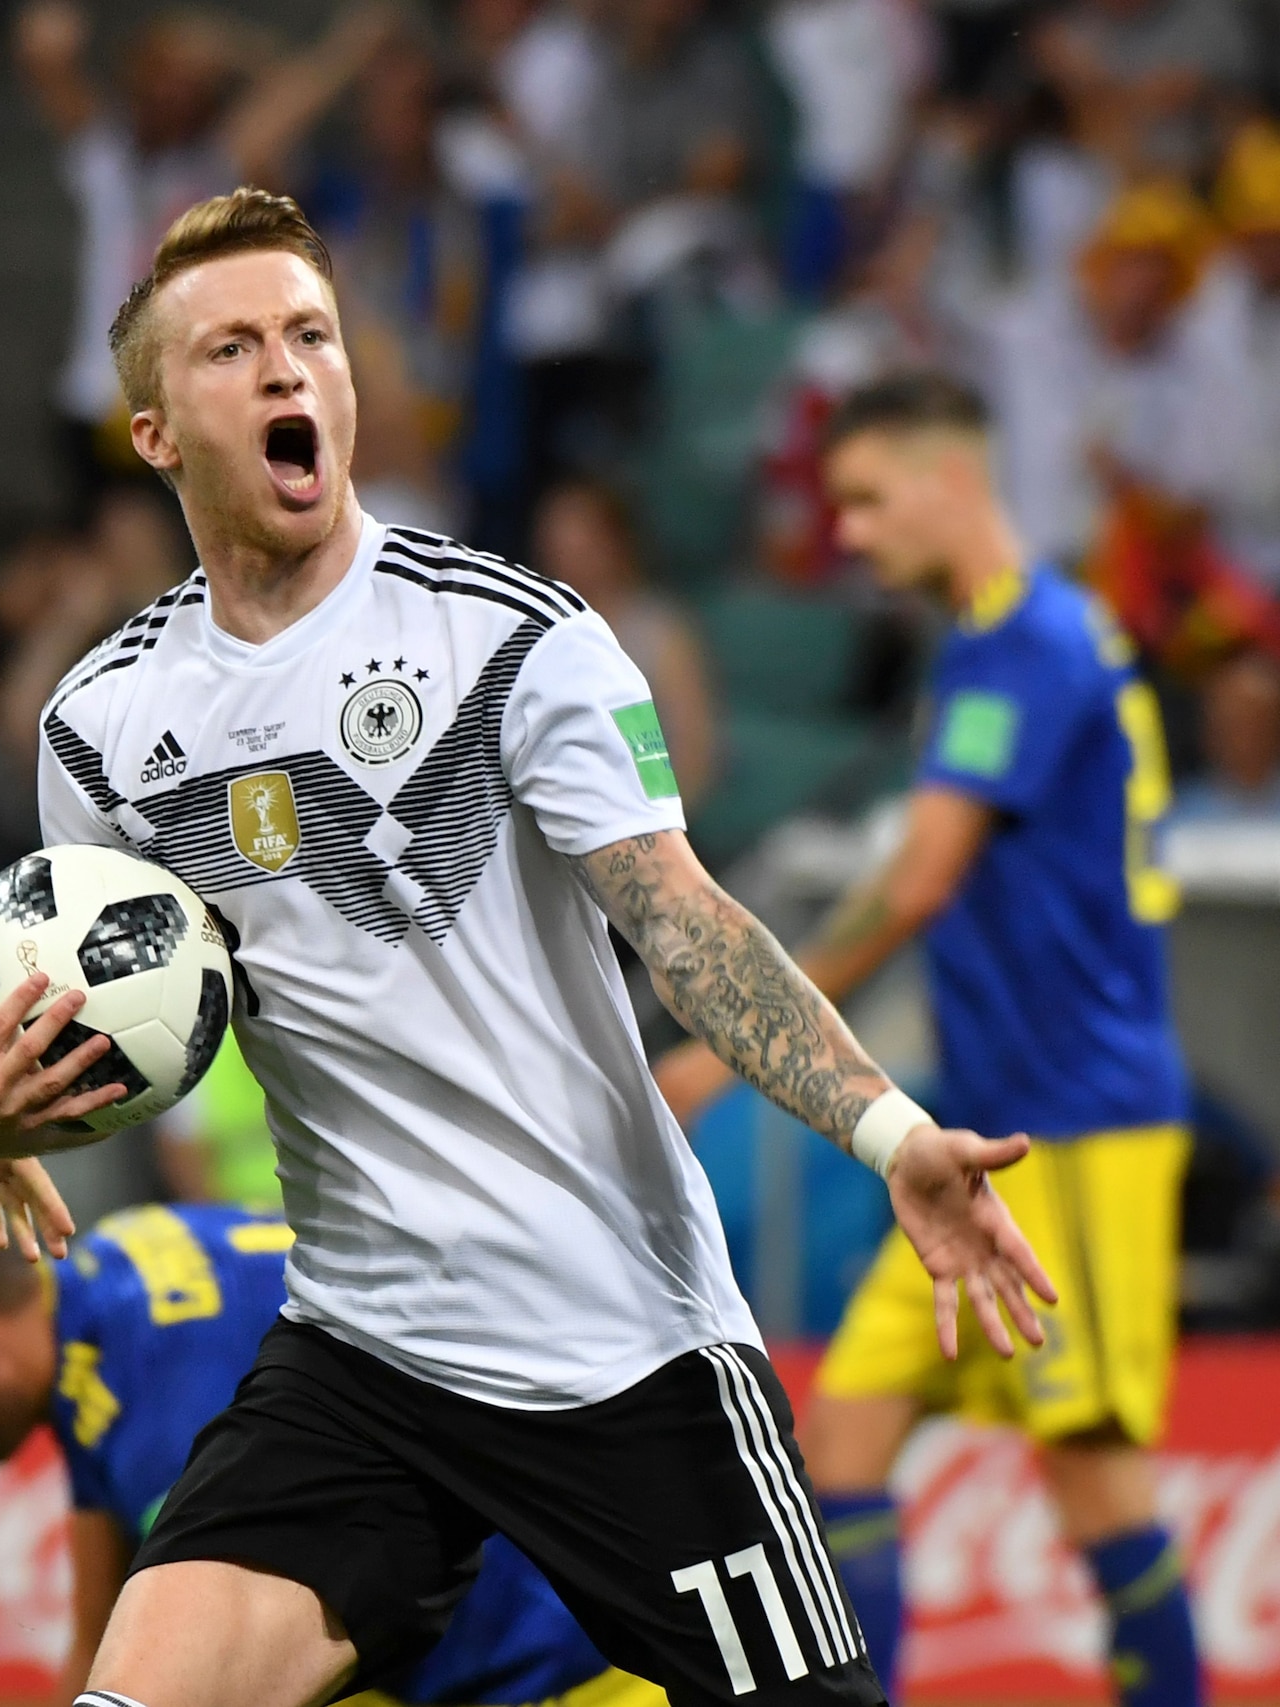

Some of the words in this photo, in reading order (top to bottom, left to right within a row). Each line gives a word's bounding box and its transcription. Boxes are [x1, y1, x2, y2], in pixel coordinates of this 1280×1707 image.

[359, 689, 403, 707] DEUTSCHER
[253, 834, 287, 851] FIFA
[263, 852, 282, 862] 2014
[670, 1542, 810, 1696] 11
